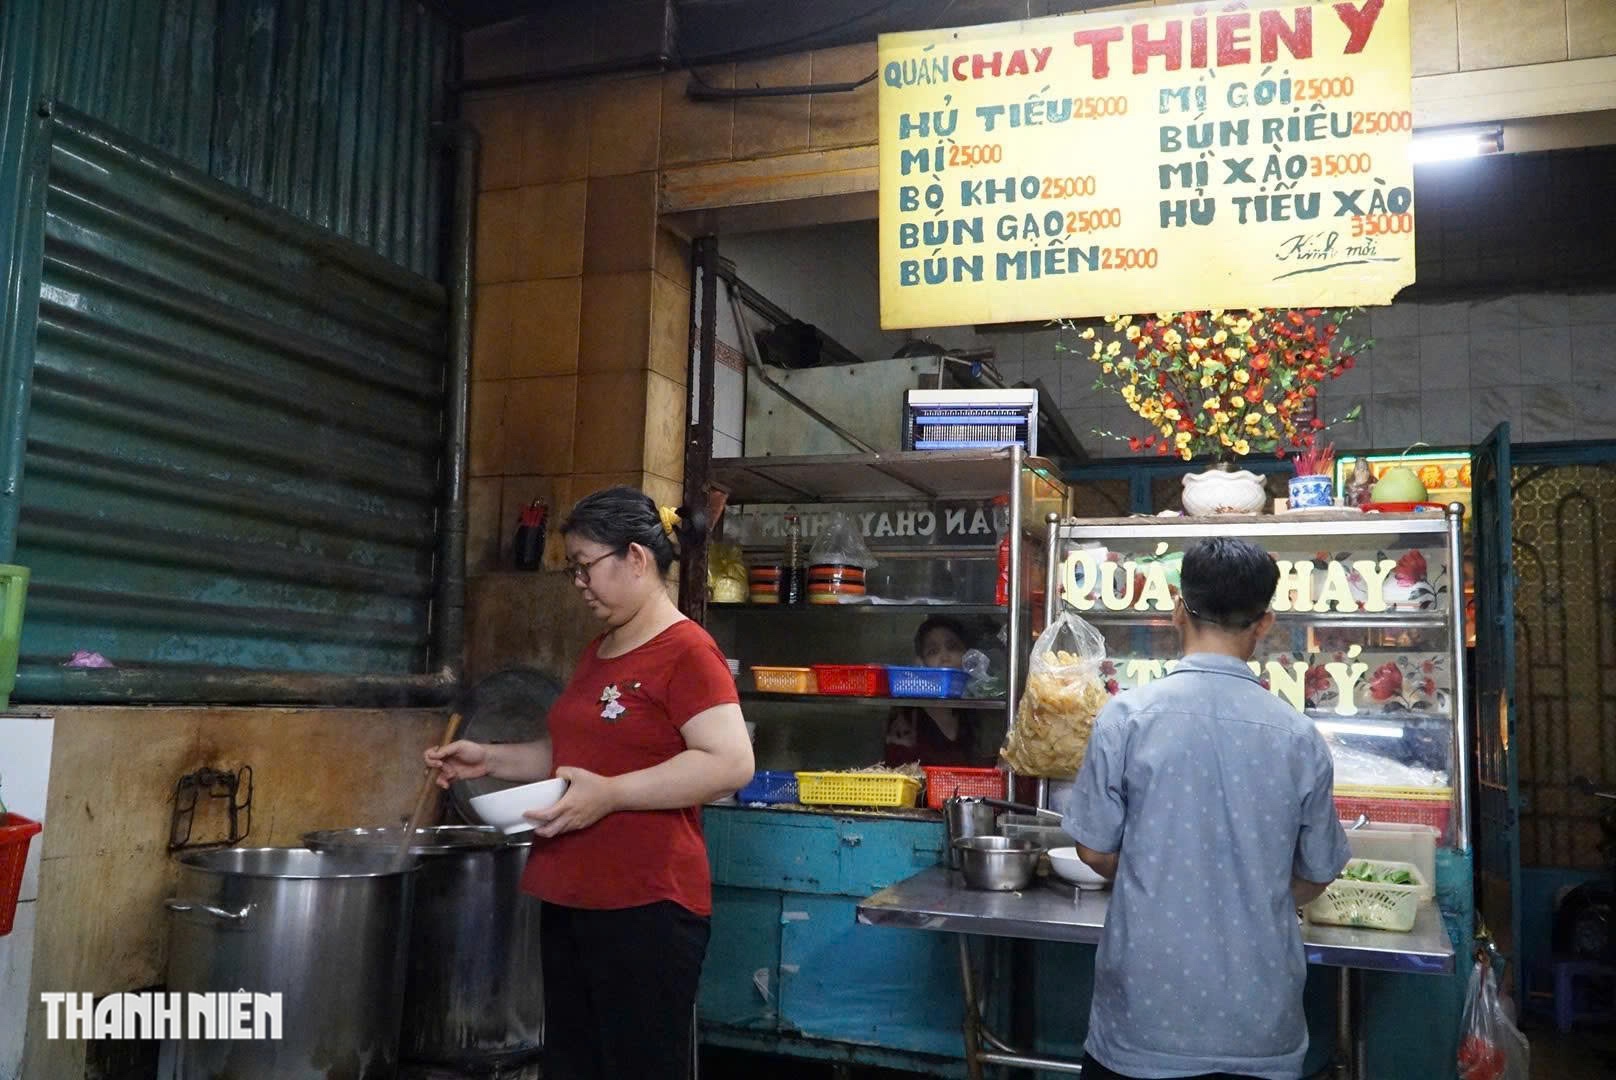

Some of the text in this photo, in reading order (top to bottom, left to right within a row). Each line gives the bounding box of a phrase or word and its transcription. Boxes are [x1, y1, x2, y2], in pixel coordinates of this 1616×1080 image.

[884, 44, 949, 88] QUÁN
[952, 46, 1053, 81] CHAY
[1074, 1, 1313, 80] THIÊN
[900, 95, 958, 139] HỦ
[976, 85, 1072, 131] TIẾU
[1159, 68, 1215, 114] MÌ
[1227, 66, 1292, 108] GÓI
[1160, 112, 1249, 153] BÚN
[1262, 100, 1352, 144] RIÊU
[901, 138, 955, 175] MÌ
[1159, 150, 1215, 189] MÌ
[900, 173, 944, 212] BÒ
[961, 176, 1040, 206] KHO
[1160, 177, 1412, 228] HỦ TIẾU XÀO
[900, 209, 984, 249] BÚN
[996, 210, 1064, 242] GẠO
[900, 248, 984, 286] BÚN
[996, 234, 1100, 281] MIẾN
[1062, 541, 1396, 613] QUÁ HAY
[1325, 644, 1368, 716] Ý
